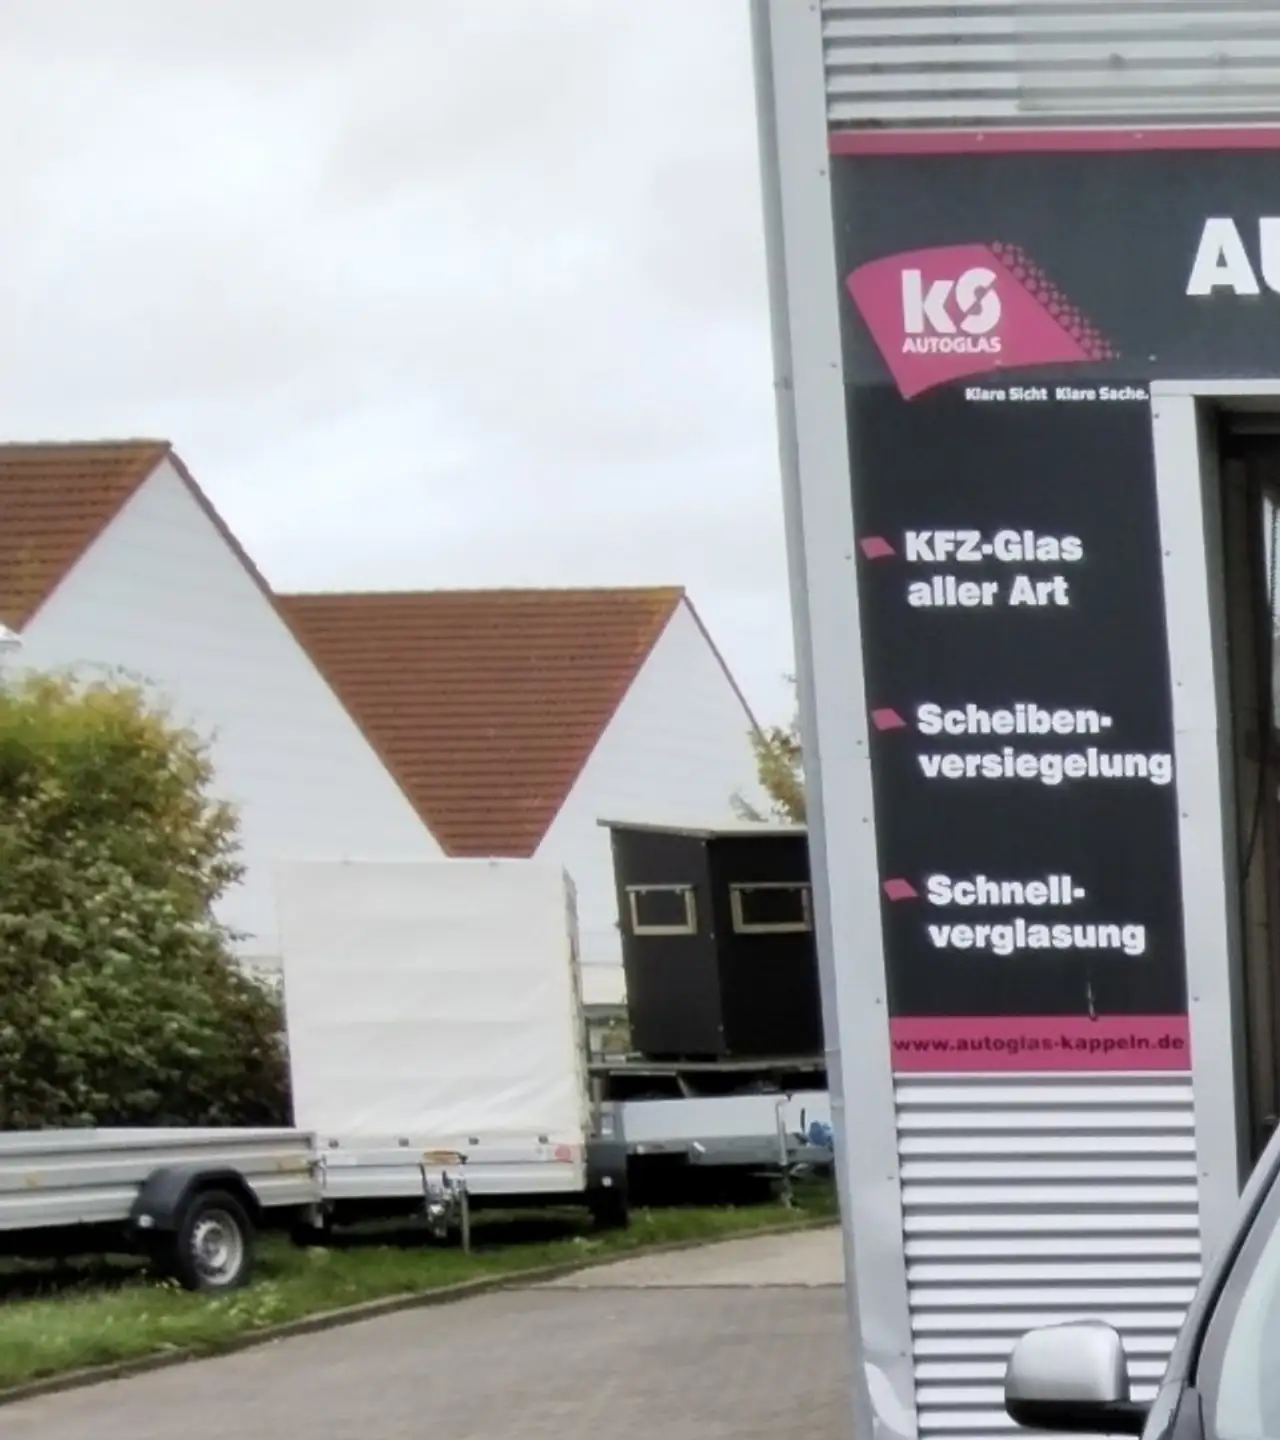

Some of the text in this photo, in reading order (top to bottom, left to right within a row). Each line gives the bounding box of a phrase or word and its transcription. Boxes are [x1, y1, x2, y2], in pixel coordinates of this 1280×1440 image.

[902, 337, 1002, 353] AUTOGLAS
[965, 387, 1005, 401] Klare
[1055, 386, 1096, 400] Klare
[1098, 386, 1149, 400] Sache.
[905, 530, 1083, 561] KFZ-Glas
[908, 576, 1069, 607] aller Art
[917, 703, 1113, 734] Scheiben-
[918, 747, 1172, 785] versiegelung
[926, 874, 1086, 905] Schnell-
[928, 919, 1146, 955] verglasung
[894, 1034, 1185, 1055] www.autoglas-kappeln.de
